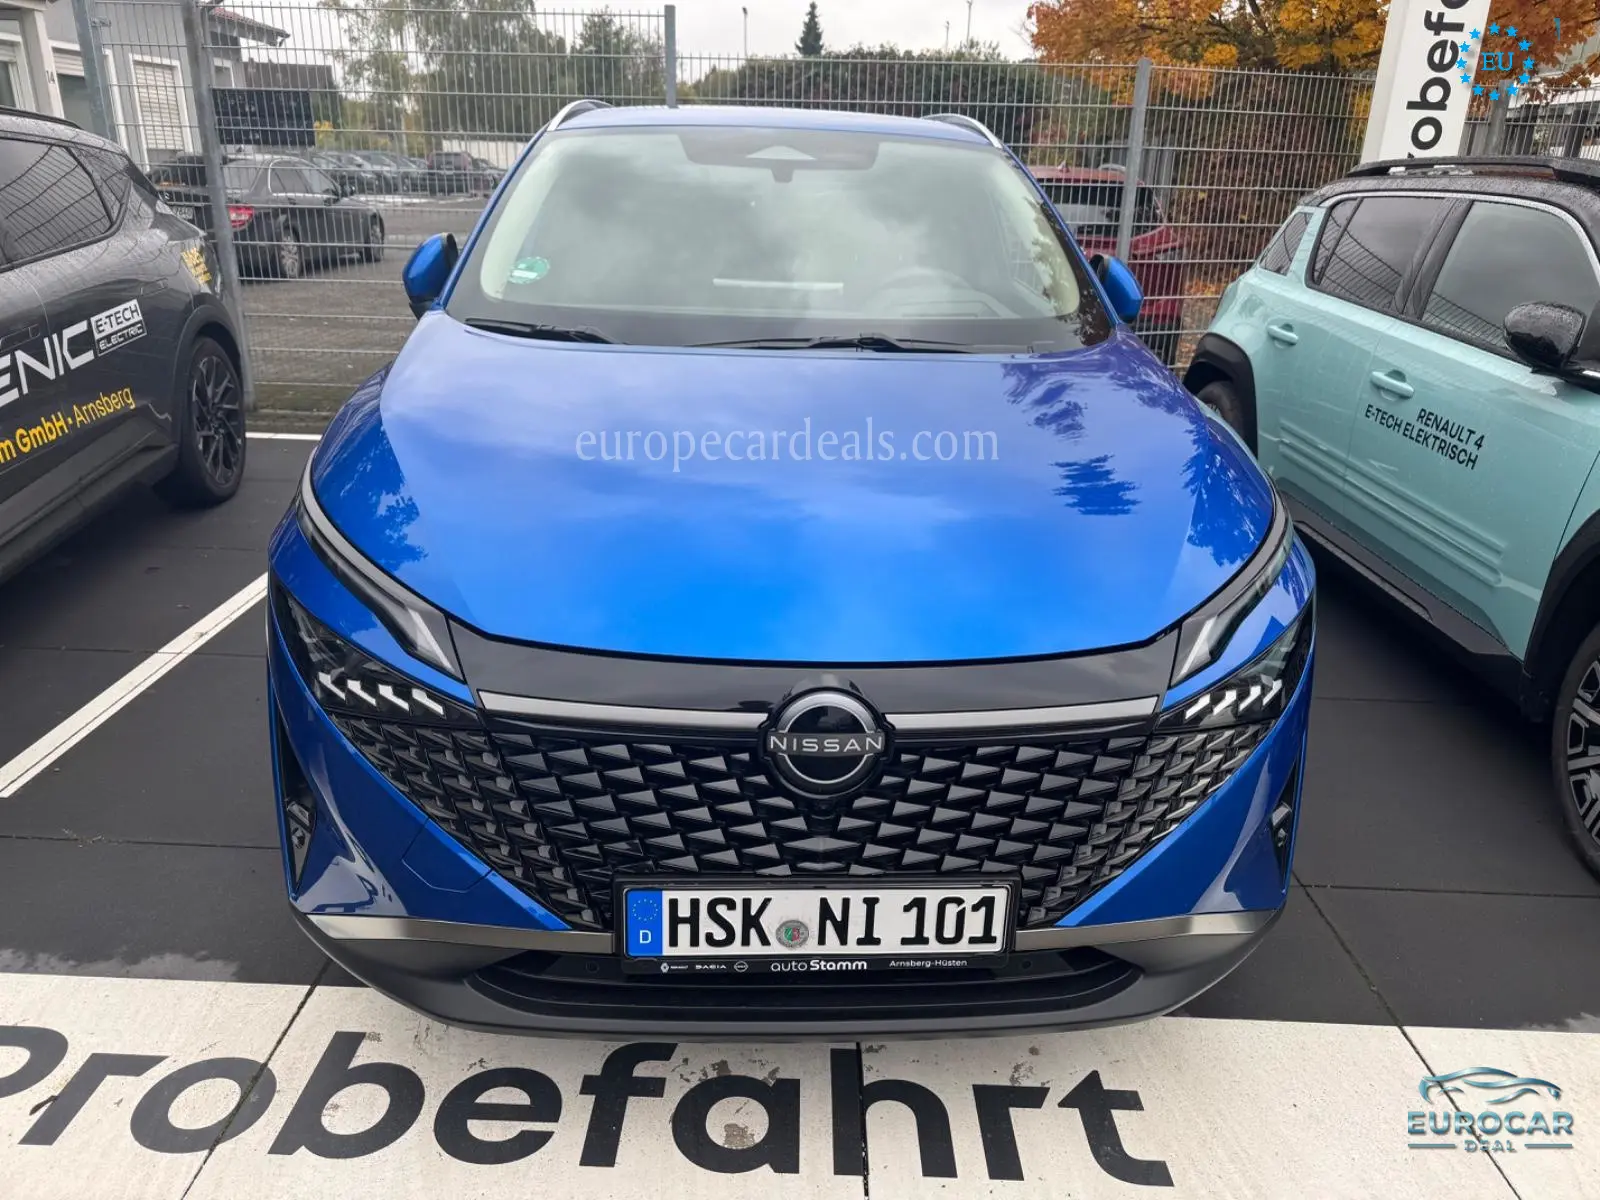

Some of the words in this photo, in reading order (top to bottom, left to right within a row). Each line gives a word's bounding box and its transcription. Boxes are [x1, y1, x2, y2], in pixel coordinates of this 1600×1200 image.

[1406, 0, 1472, 158] obef
[95, 304, 140, 334] E-TECH
[99, 323, 144, 350] ELECTRIC
[16, 411, 69, 453] GmbH
[73, 387, 136, 428] Arnsberg
[1365, 404, 1403, 433] E-TECH
[1402, 421, 1478, 470] ELEKTRISCH
[1416, 408, 1476, 445] RENAULT
[1474, 434, 1485, 451] 4
[770, 735, 882, 752] NISSAN
[639, 930, 652, 944] D
[668, 897, 773, 948] HSK
[818, 897, 881, 946] NI
[900, 896, 997, 945] 101
[889, 959, 968, 968] Arnsberg-Hüsten
